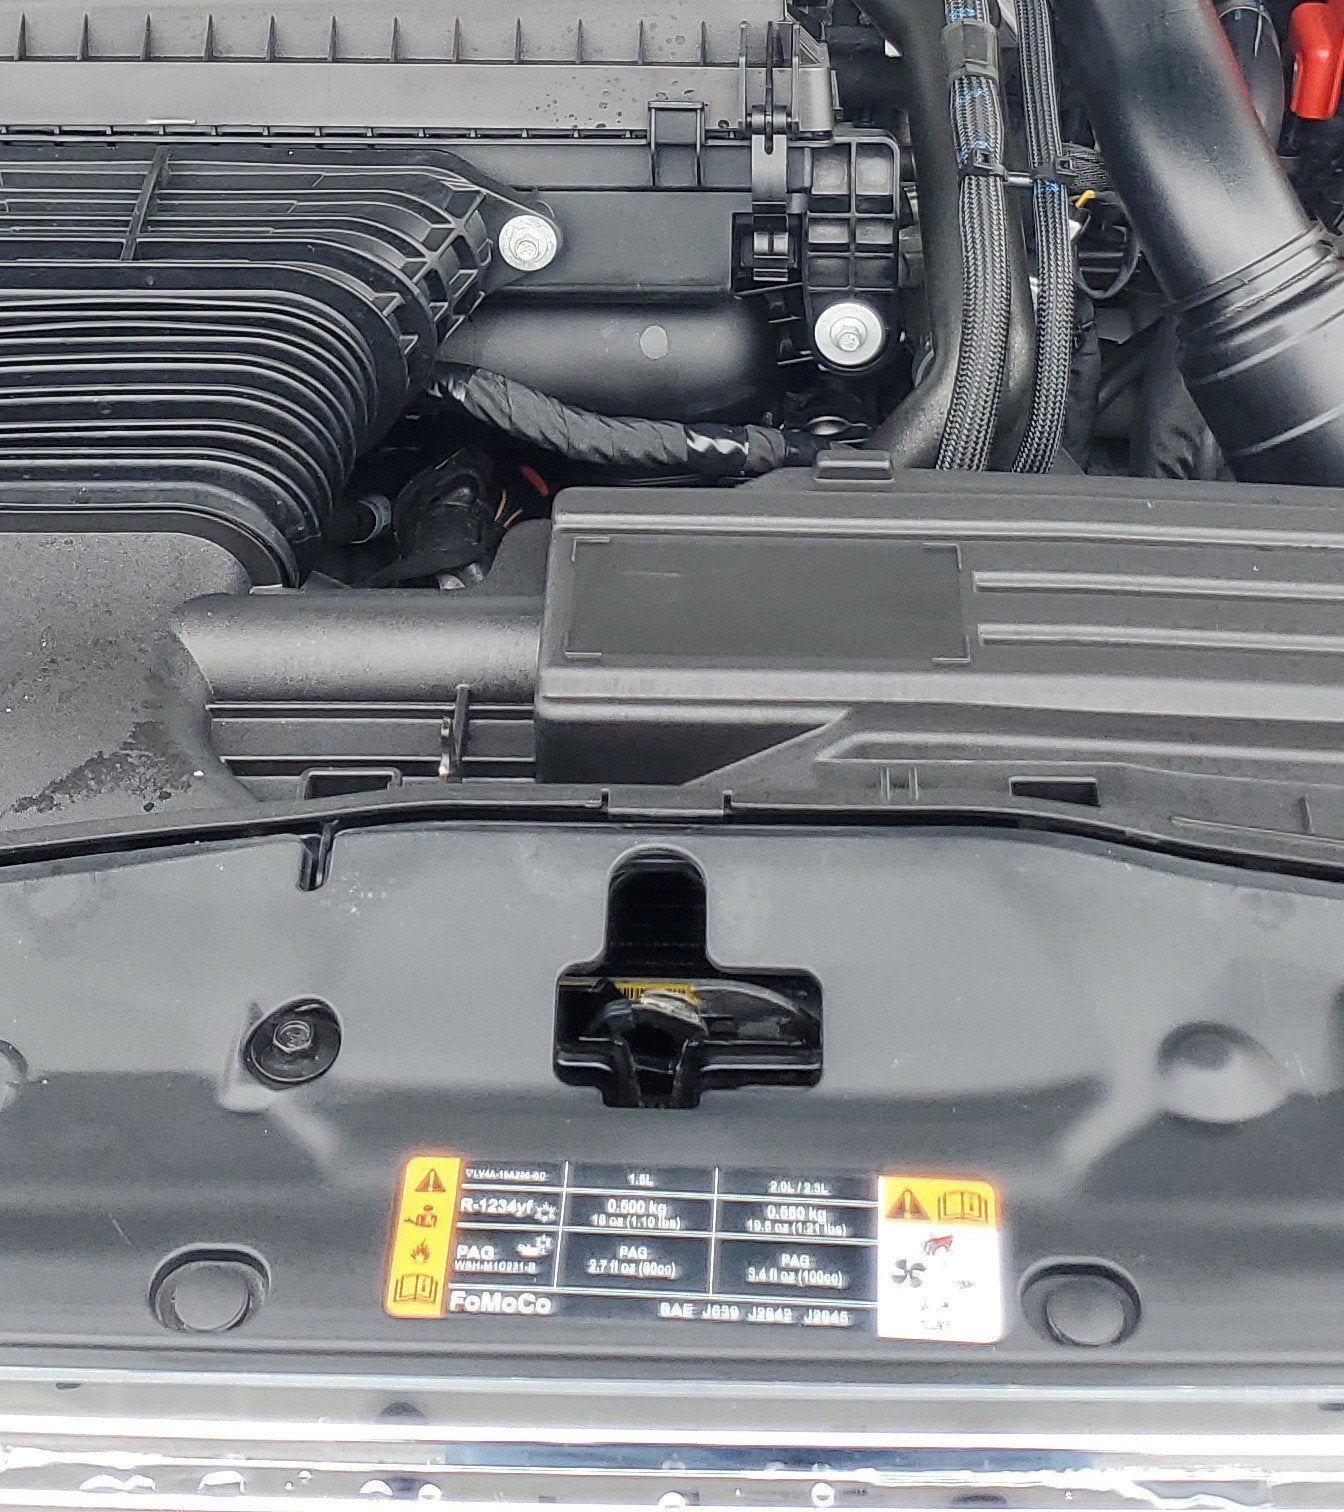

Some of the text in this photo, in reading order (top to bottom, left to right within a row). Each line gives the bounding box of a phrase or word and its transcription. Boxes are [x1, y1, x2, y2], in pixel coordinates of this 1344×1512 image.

[460, 1197, 534, 1216] R-1234yf
[649, 1199, 667, 1217] kg
[808, 1206, 827, 1225] kg
[456, 1244, 496, 1260] PAG
[619, 1245, 648, 1260] PAG
[781, 1253, 810, 1268] PAG
[449, 1290, 552, 1315] FoMoCo
